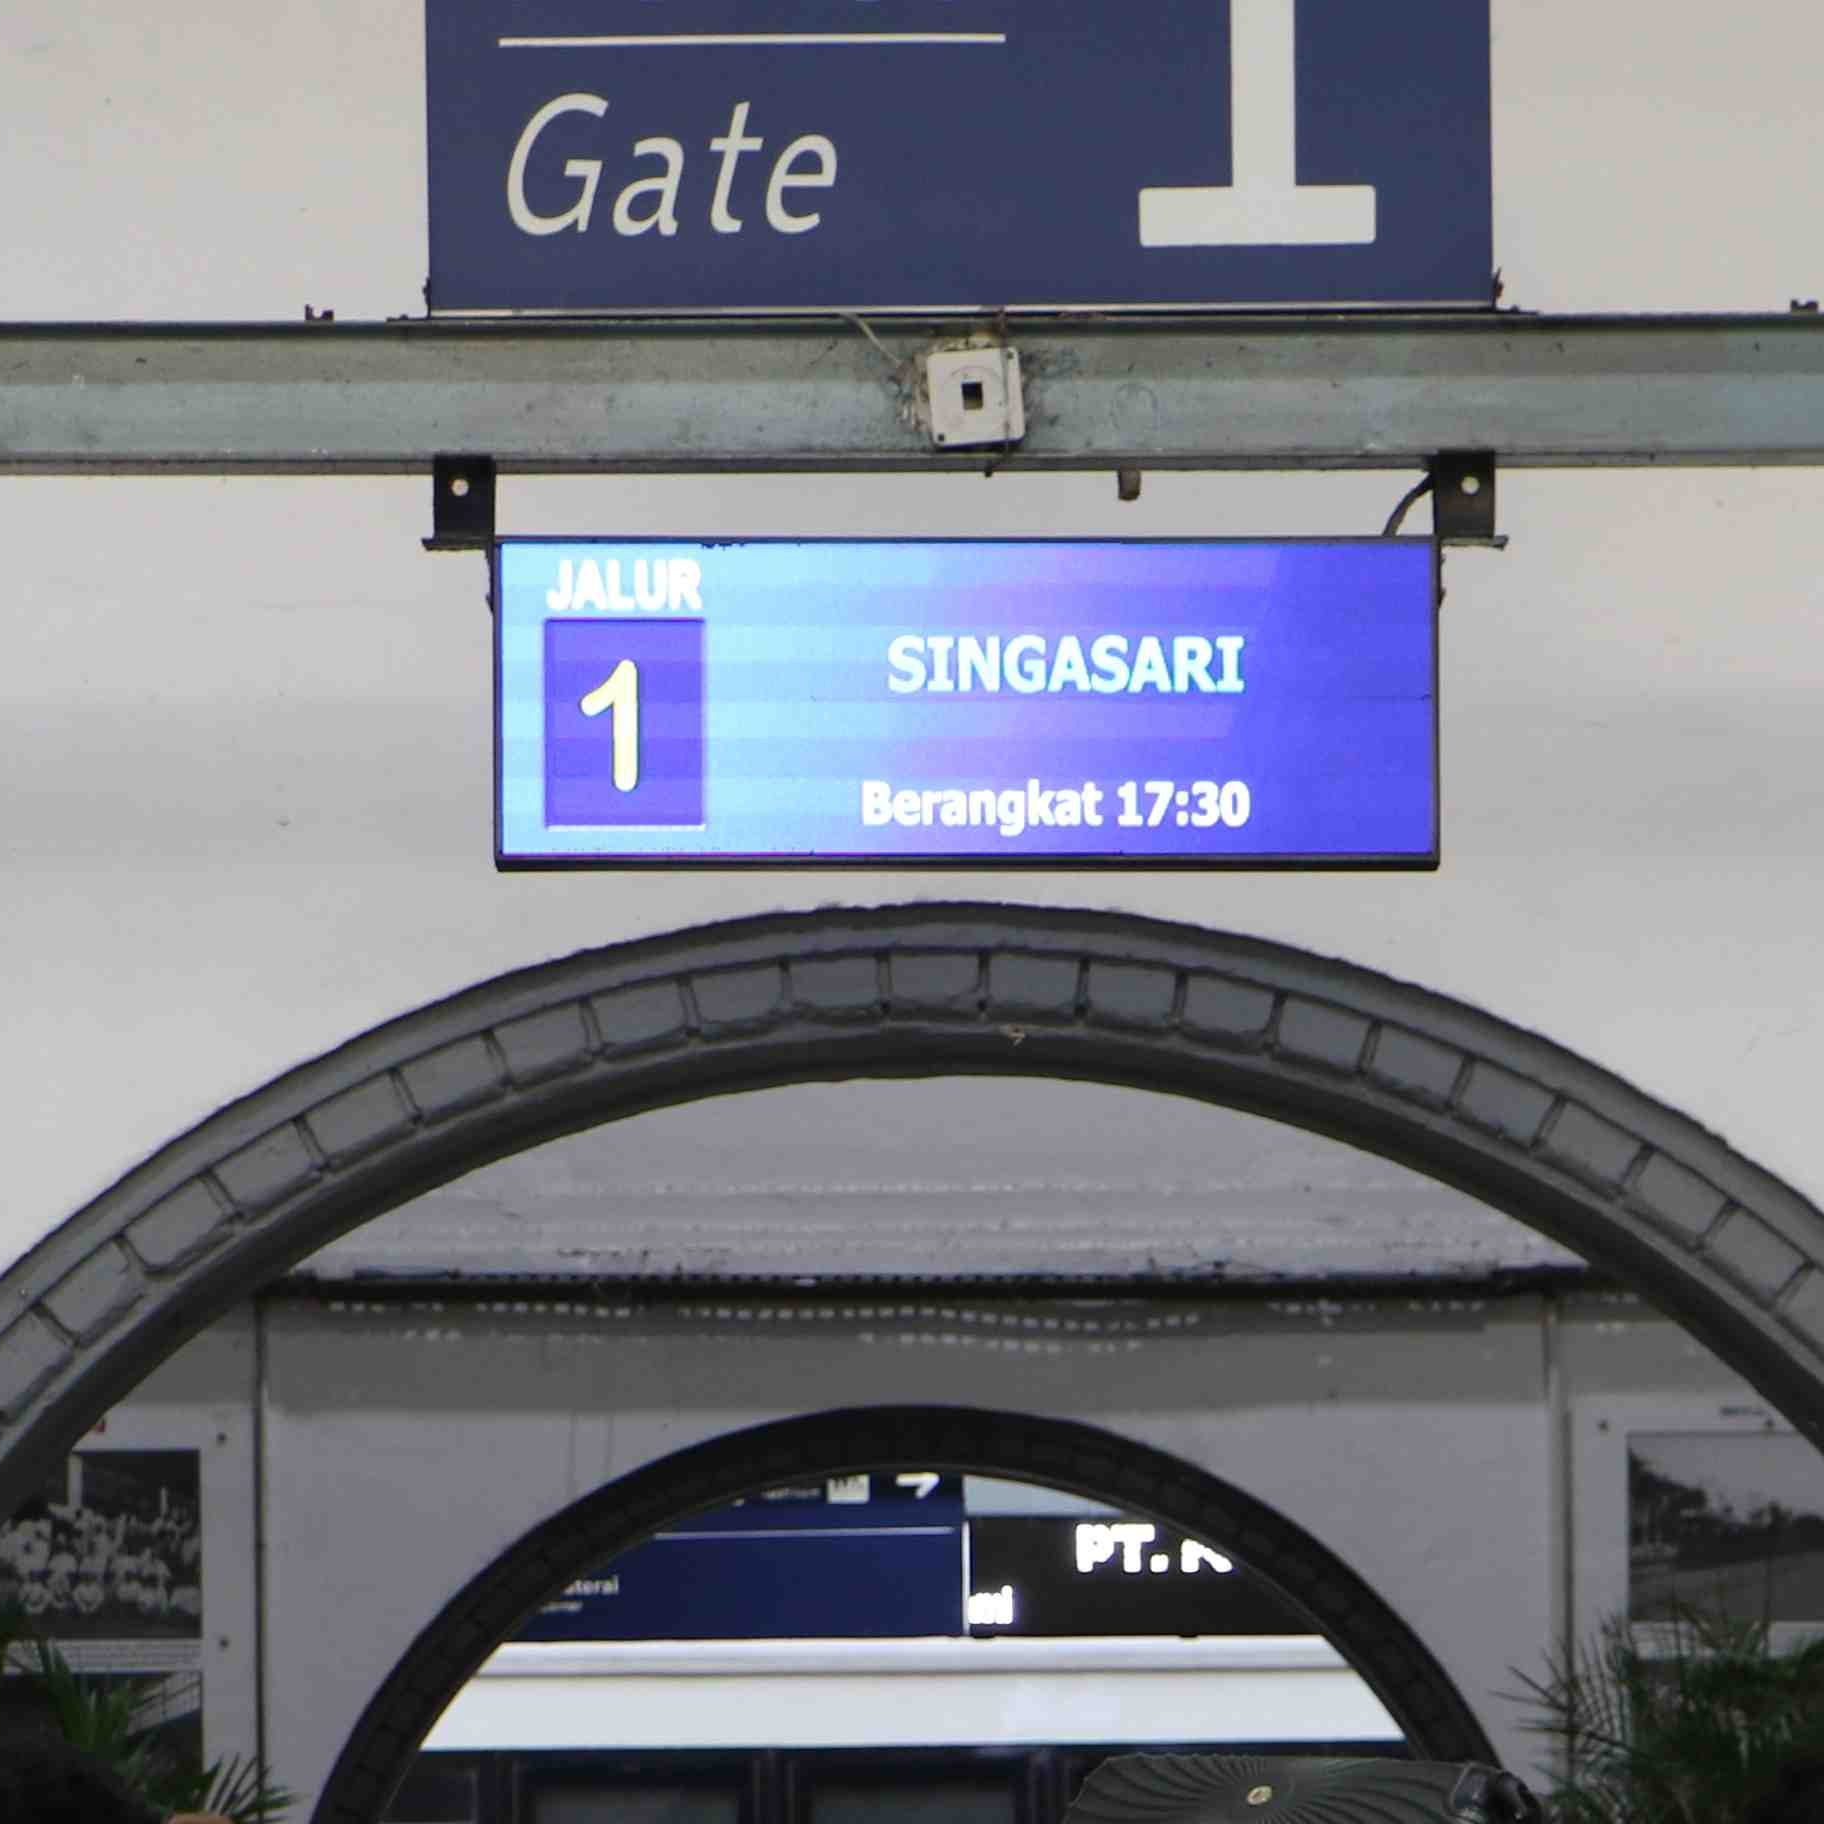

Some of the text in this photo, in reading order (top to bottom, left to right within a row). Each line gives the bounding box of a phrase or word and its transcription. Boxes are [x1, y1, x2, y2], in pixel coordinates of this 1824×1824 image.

[1138, 0, 1377, 247] 1
[504, 93, 839, 236] Gate
[545, 559, 702, 610] JALUR
[886, 634, 1248, 695] SINGASARI
[578, 658, 639, 793] 1
[861, 780, 1251, 838] Berangkat 17:30
[1074, 1523, 1170, 1574] PT.
